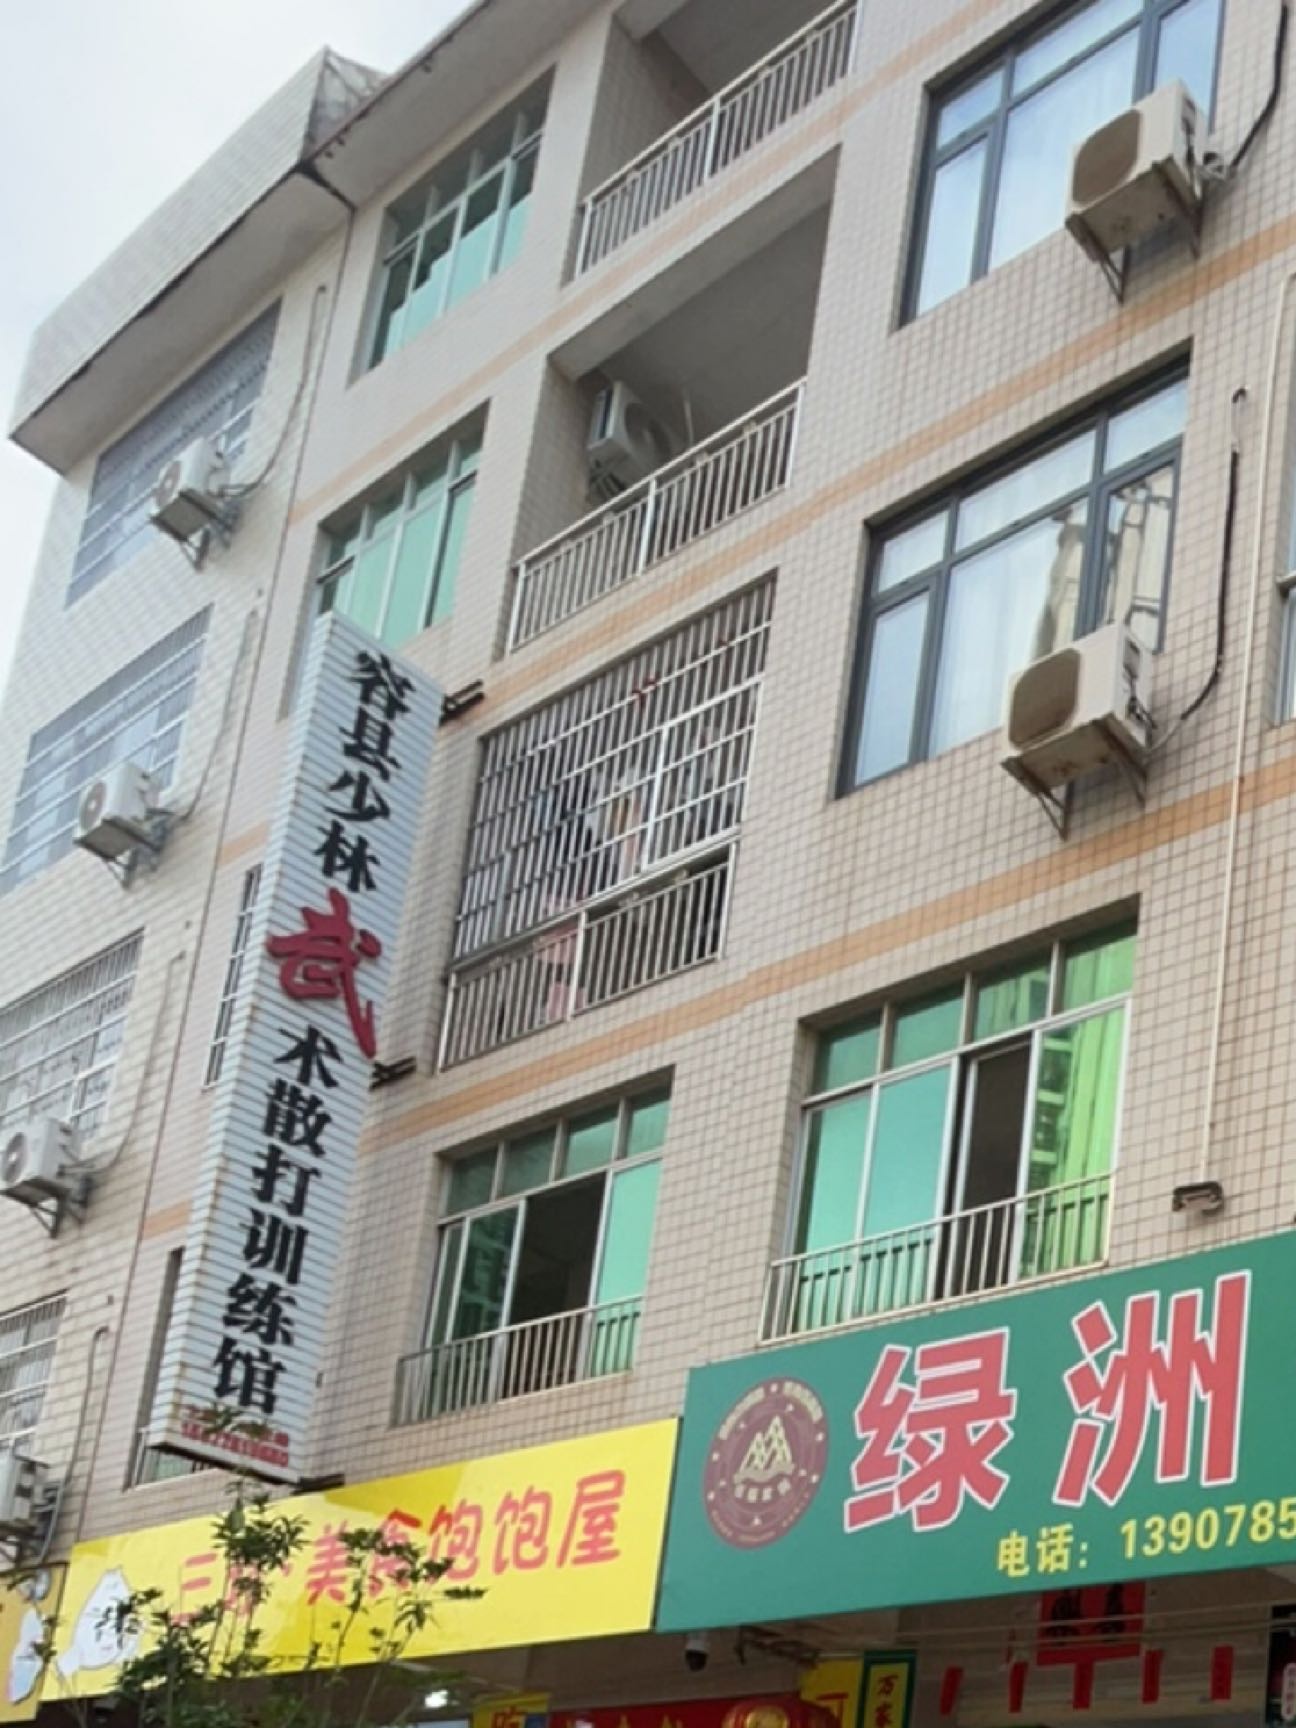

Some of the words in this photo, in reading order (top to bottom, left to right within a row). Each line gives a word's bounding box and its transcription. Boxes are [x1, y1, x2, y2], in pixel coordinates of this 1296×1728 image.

[211, 650, 418, 1414] 容县少林武术散打训练馆
